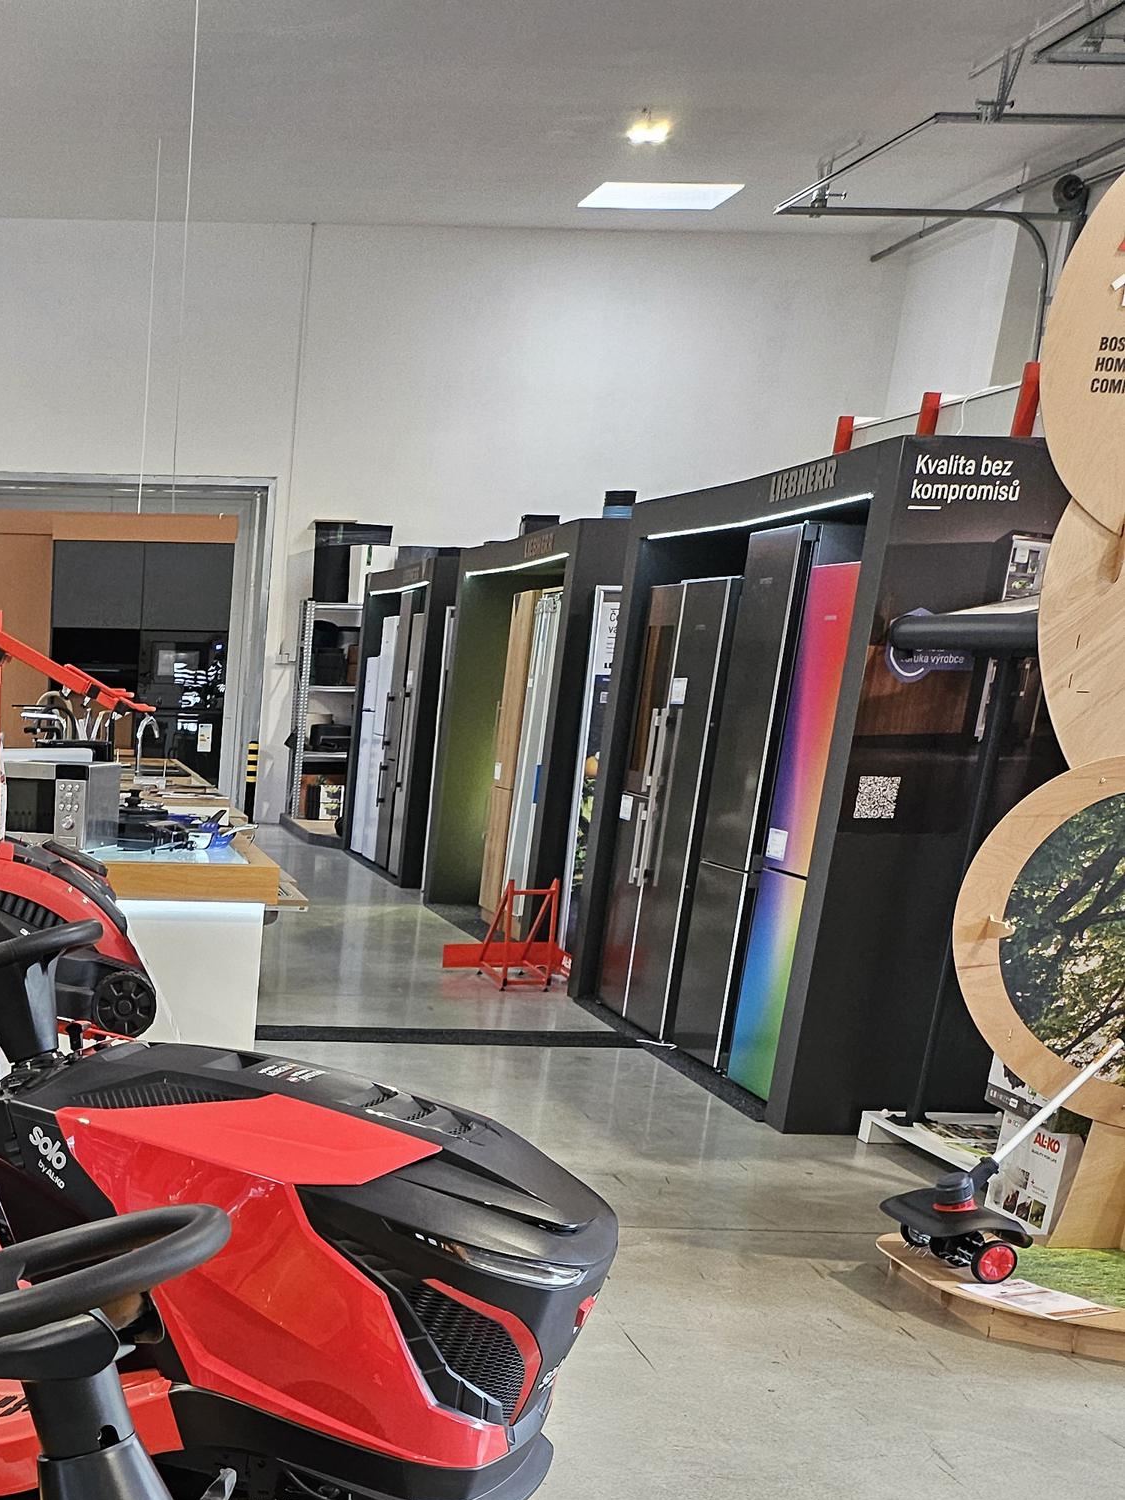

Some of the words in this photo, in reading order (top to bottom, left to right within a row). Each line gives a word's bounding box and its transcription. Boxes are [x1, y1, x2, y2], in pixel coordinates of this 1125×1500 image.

[915, 454, 975, 476] Kvalita
[980, 456, 1014, 476] bez
[770, 459, 838, 503] LIEBHERR
[910, 479, 1020, 504] kompromisů
[29, 1126, 67, 1170] solo
[38, 1159, 48, 1173] by
